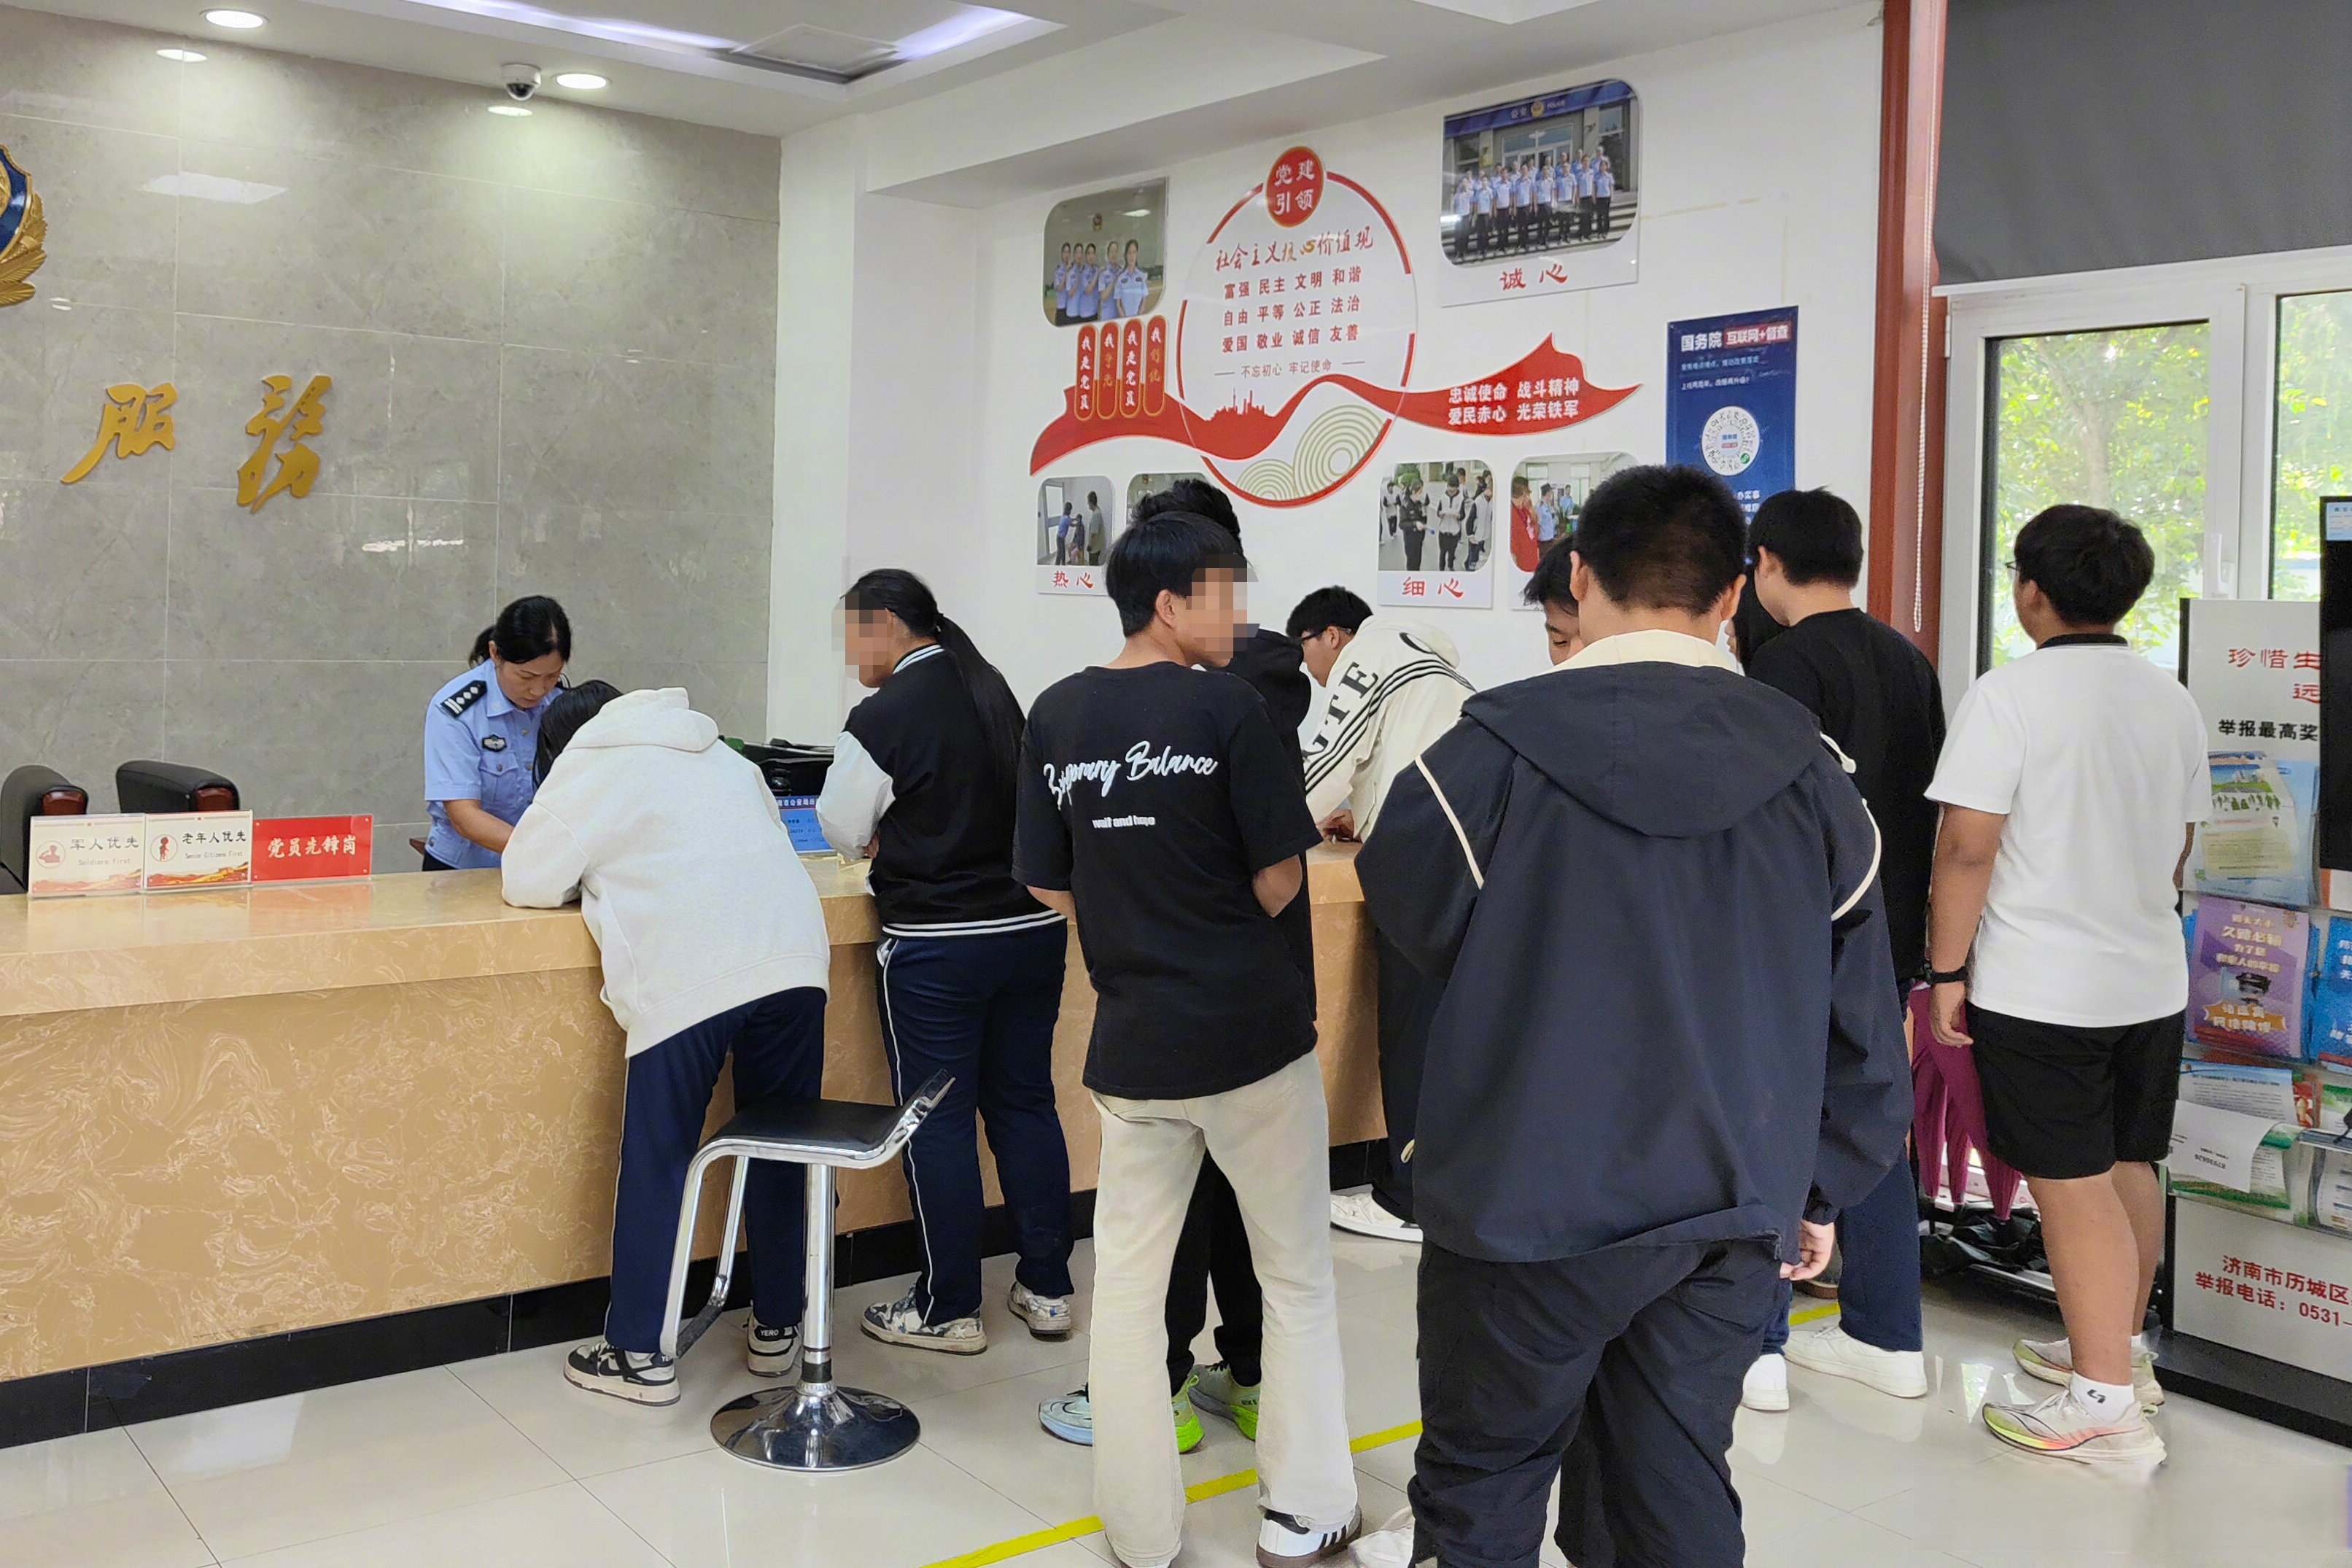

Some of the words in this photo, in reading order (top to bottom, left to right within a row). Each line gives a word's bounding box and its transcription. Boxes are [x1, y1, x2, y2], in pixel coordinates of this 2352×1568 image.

[1274, 159, 1316, 186] 党建
[1274, 189, 1313, 215] 引领
[1223, 281, 1249, 300] 富强
[1258, 276, 1286, 295] 民主
[1295, 271, 1323, 290] 文明
[1332, 265, 1362, 285] 和谐
[1499, 263, 1568, 290] 诚心
[1223, 308, 1249, 326] 自由
[1257, 303, 1284, 323] 平等
[1293, 300, 1321, 319] 公正
[1331, 295, 1360, 314] 法治
[1222, 335, 1248, 353] 爱国
[1256, 332, 1284, 350] 敬业
[1292, 327, 1320, 346] 诚信
[1330, 323, 1358, 343] 友善
[1681, 331, 1722, 352] 国务院
[1726, 325, 1789, 345] 互联网+督查
[1241, 362, 1283, 379] 不忘初心
[1288, 358, 1332, 374] 牢记使命
[1448, 382, 1507, 405] 忠诚使命
[1517, 377, 1579, 399] 战斗精神
[1448, 405, 1507, 426] 爱民赤心
[1516, 400, 1579, 422] 光荣铁军
[1052, 570, 1094, 589] 热心
[1402, 576, 1464, 598] 细心
[2227, 648, 2321, 669] 珍惜生
[2292, 683, 2321, 704] 远
[2219, 718, 2318, 742] 举报最高奖
[1125, 740, 1219, 781] Balance
[1092, 817, 1112, 828] wait
[1113, 815, 1133, 828] and
[1133, 815, 1156, 827] hope
[70, 836, 139, 850] 军人优先
[182, 830, 247, 844] 老年人优先
[268, 834, 356, 858] 党员先锋岗
[2223, 1255, 2352, 1305] 济南市历城区
